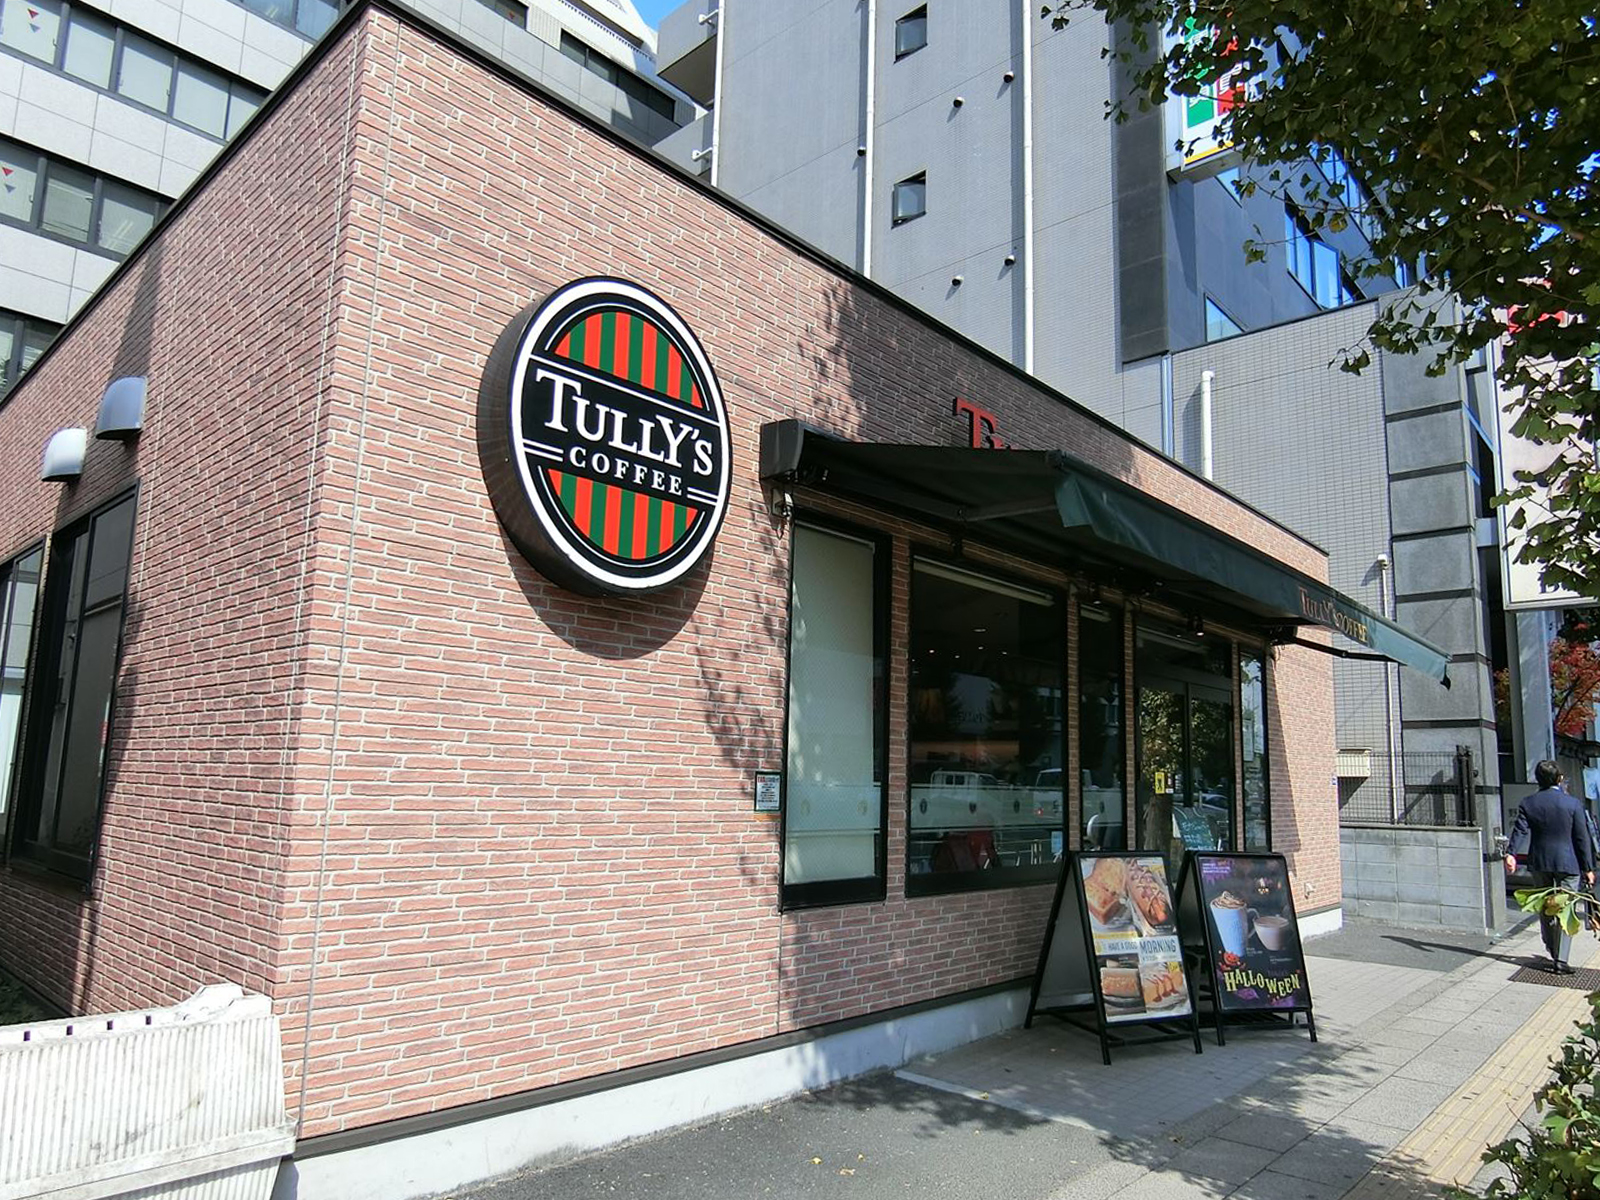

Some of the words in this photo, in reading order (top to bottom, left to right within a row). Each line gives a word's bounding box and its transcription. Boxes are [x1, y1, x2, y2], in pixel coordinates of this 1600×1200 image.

[535, 368, 713, 477] TULLY'S
[568, 446, 683, 497] COFFEE
[1139, 939, 1177, 954] MORNING
[1223, 968, 1301, 997] HALLOWEEN
